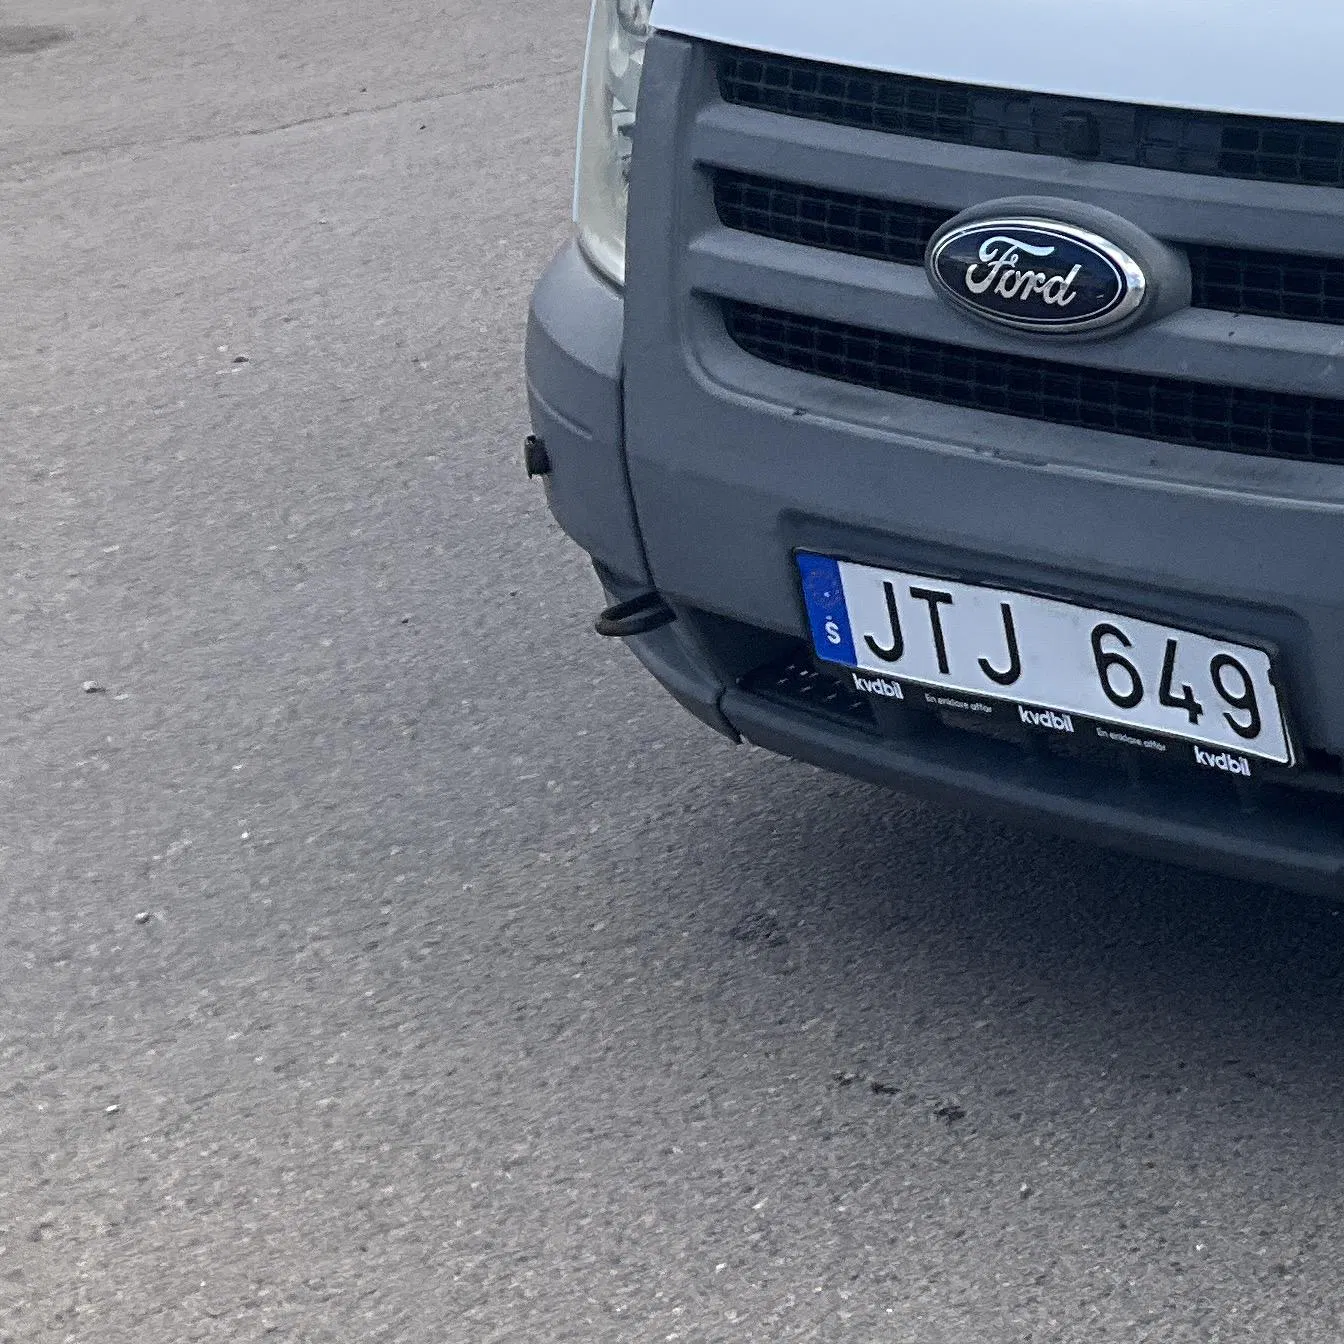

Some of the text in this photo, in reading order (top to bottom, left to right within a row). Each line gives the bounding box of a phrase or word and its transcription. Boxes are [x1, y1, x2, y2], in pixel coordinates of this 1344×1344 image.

[965, 236, 1082, 306] Ford
[824, 620, 842, 645] S
[863, 581, 1261, 740] JTJ 649
[852, 673, 904, 700] kvdbil
[1018, 705, 1075, 733] kvdbil
[1193, 745, 1251, 777] kvdbil
